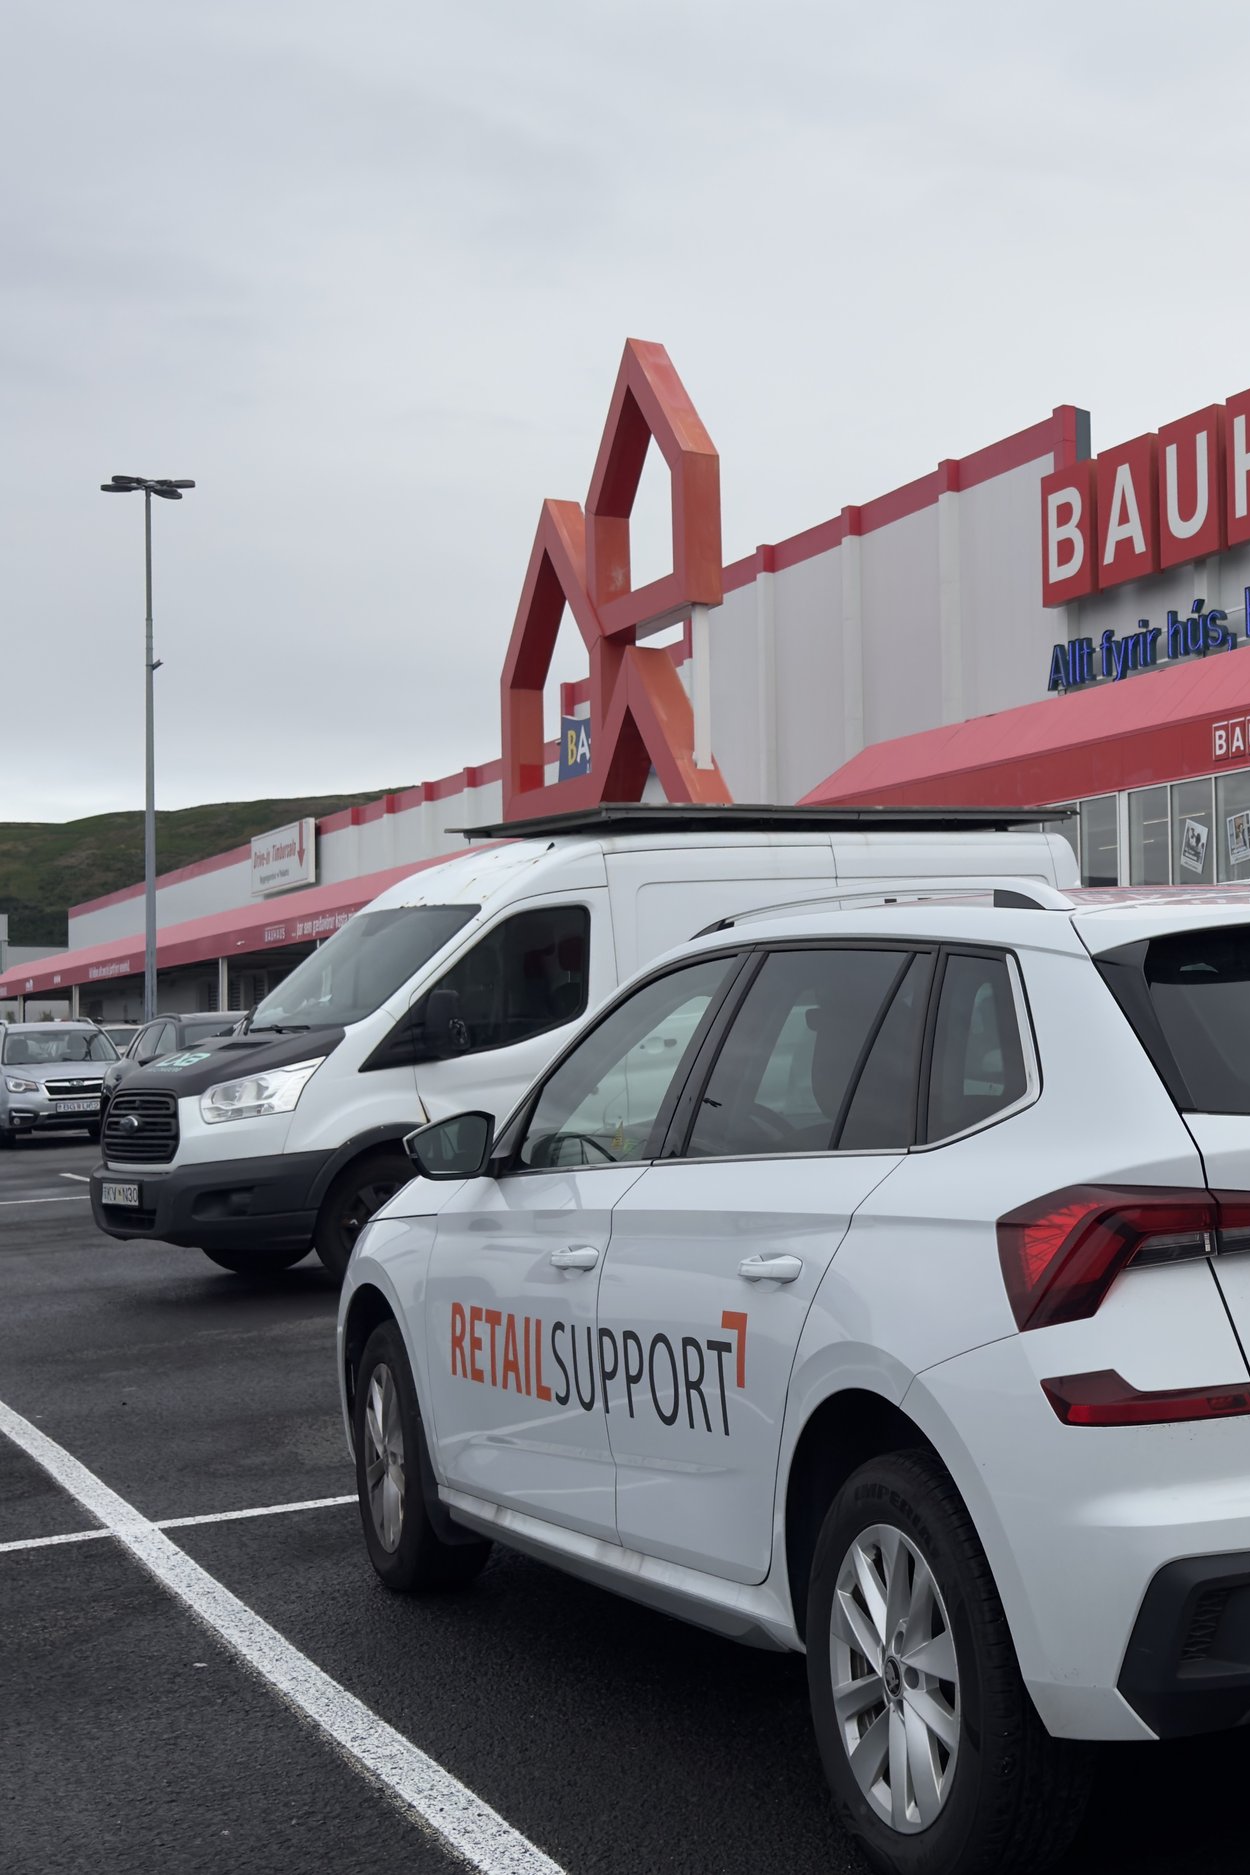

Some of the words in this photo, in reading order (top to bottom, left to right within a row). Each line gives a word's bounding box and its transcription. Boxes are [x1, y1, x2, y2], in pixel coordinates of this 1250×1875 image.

[1048, 637, 1096, 691] Allt
[1100, 619, 1161, 681] fyrir
[1167, 598, 1237, 659] hús,
[567, 725, 591, 766] BA
[451, 1302, 733, 1437] RETAILSUPPORT
